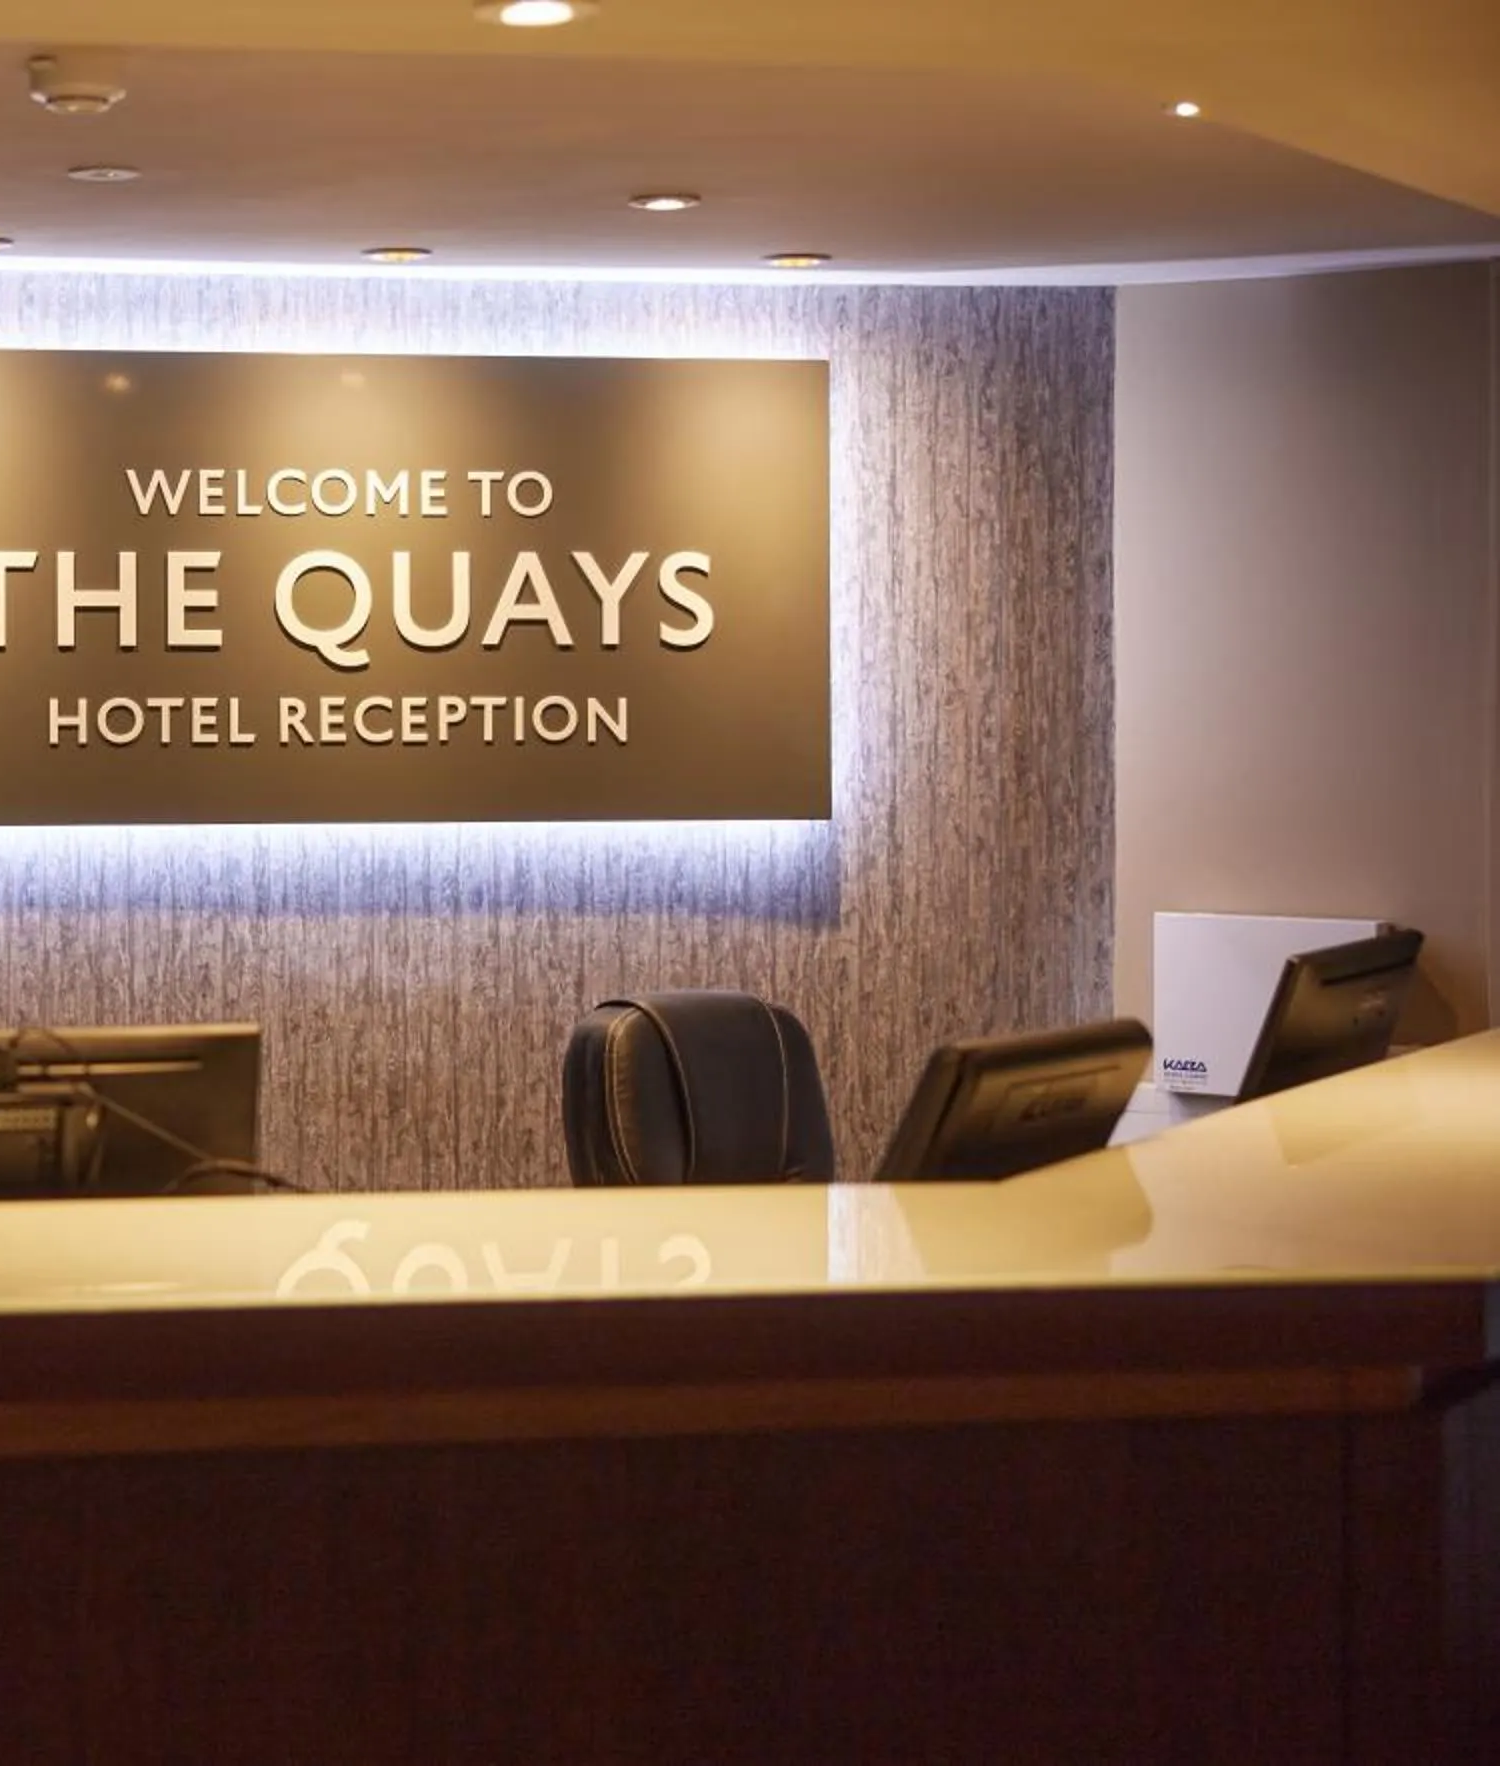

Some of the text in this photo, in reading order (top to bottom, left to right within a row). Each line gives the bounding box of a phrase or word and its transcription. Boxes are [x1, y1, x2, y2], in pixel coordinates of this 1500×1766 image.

[125, 465, 555, 520] WELCOME TO
[273, 547, 717, 671] QUAYS
[47, 694, 631, 748] HOTEL RECEPTION
